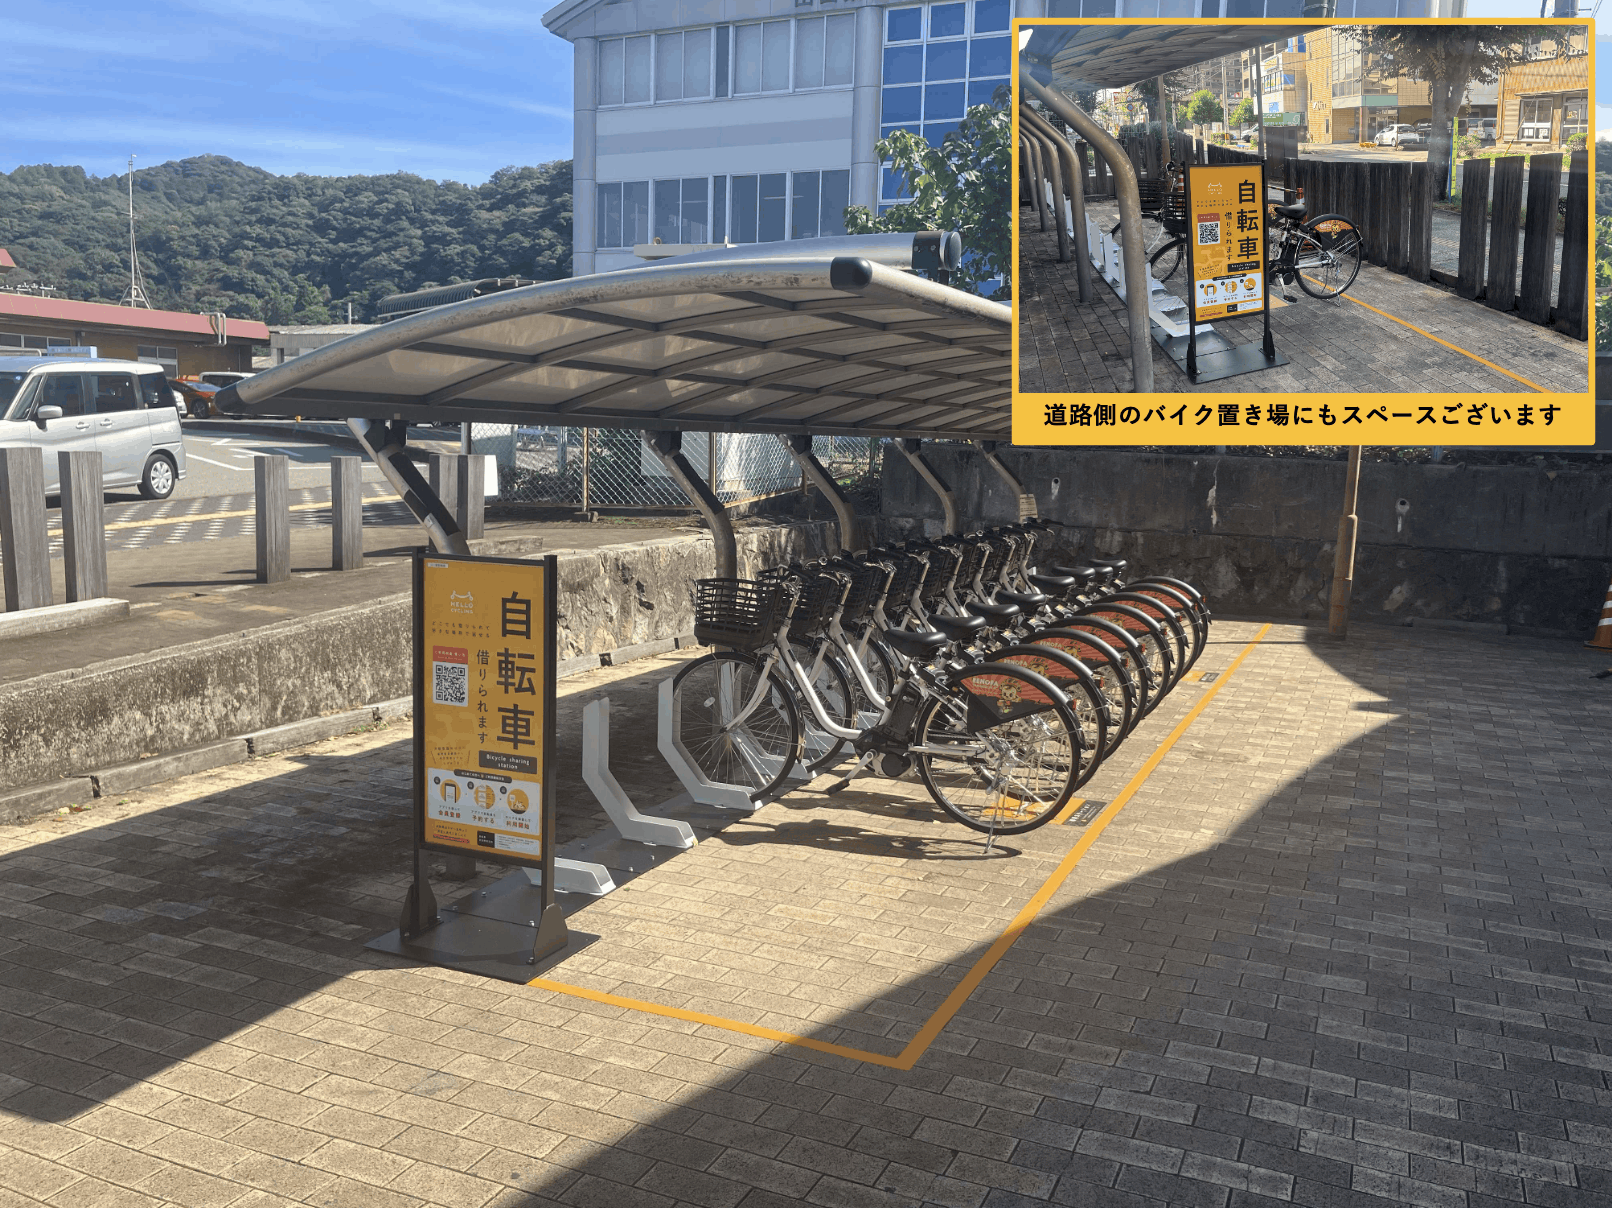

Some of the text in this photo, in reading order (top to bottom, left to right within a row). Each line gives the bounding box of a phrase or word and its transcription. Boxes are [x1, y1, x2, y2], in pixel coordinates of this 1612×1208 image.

[1236, 179, 1259, 259] 自転車
[1225, 211, 1233, 261] 借りられます
[450, 601, 474, 609] HELLO
[496, 591, 536, 750] 自転車
[972, 677, 999, 687] RENOFA
[476, 649, 490, 744] 借りられます
[486, 753, 530, 766] Bicycle sharing
[498, 762, 518, 770] station
